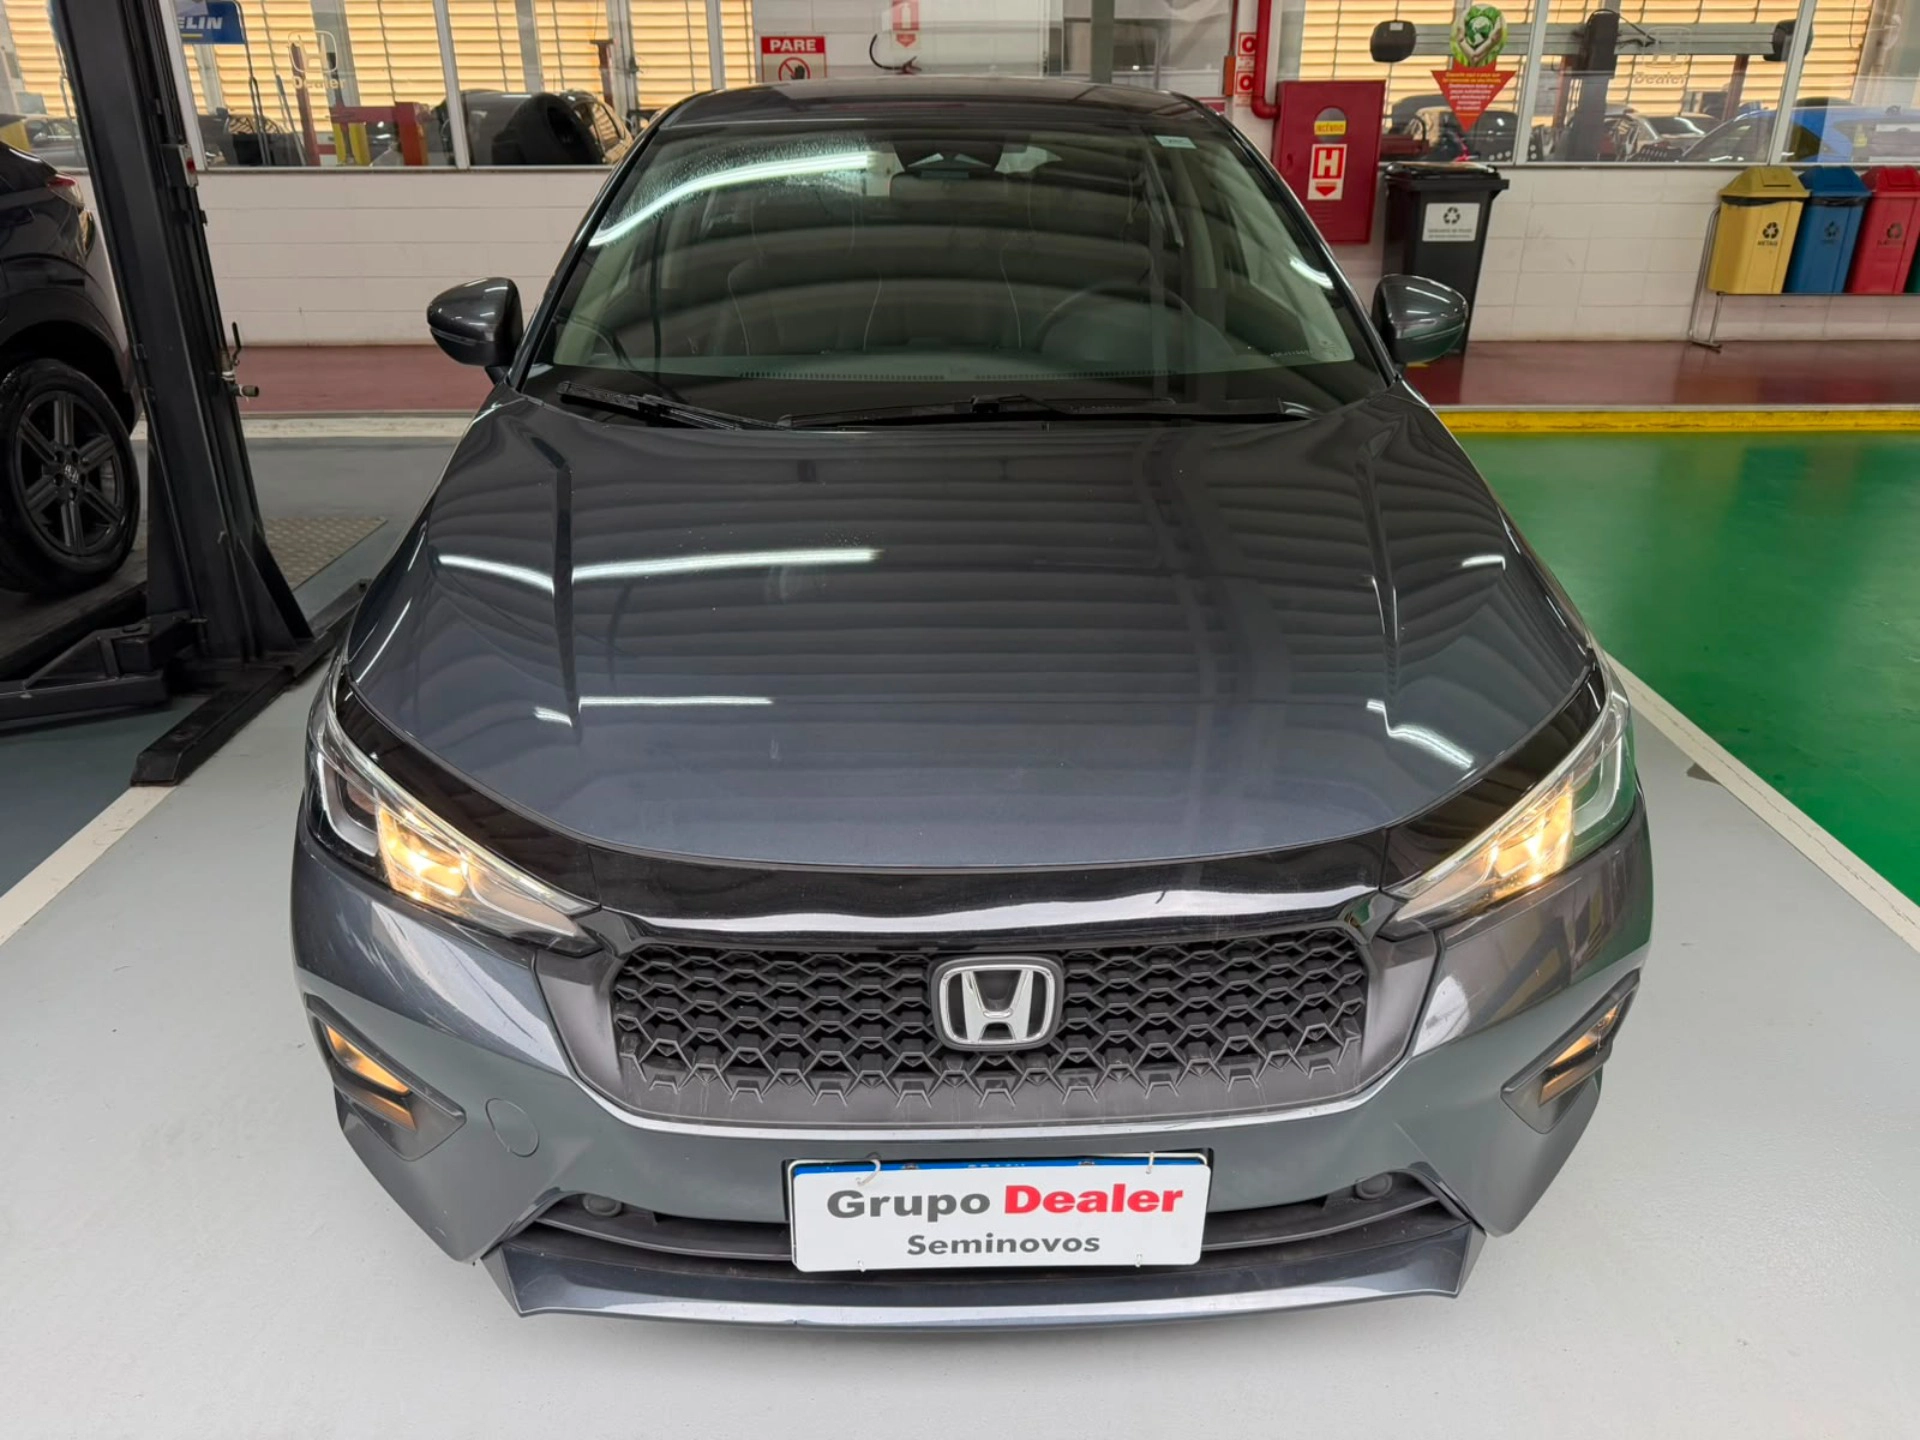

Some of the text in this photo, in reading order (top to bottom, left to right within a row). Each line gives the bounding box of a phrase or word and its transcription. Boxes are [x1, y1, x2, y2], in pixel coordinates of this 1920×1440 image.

[769, 39, 817, 52] PARE
[1316, 149, 1340, 177] H
[826, 1183, 1184, 1223] Grupo Dealer
[906, 1231, 1101, 1256] Seminovos
